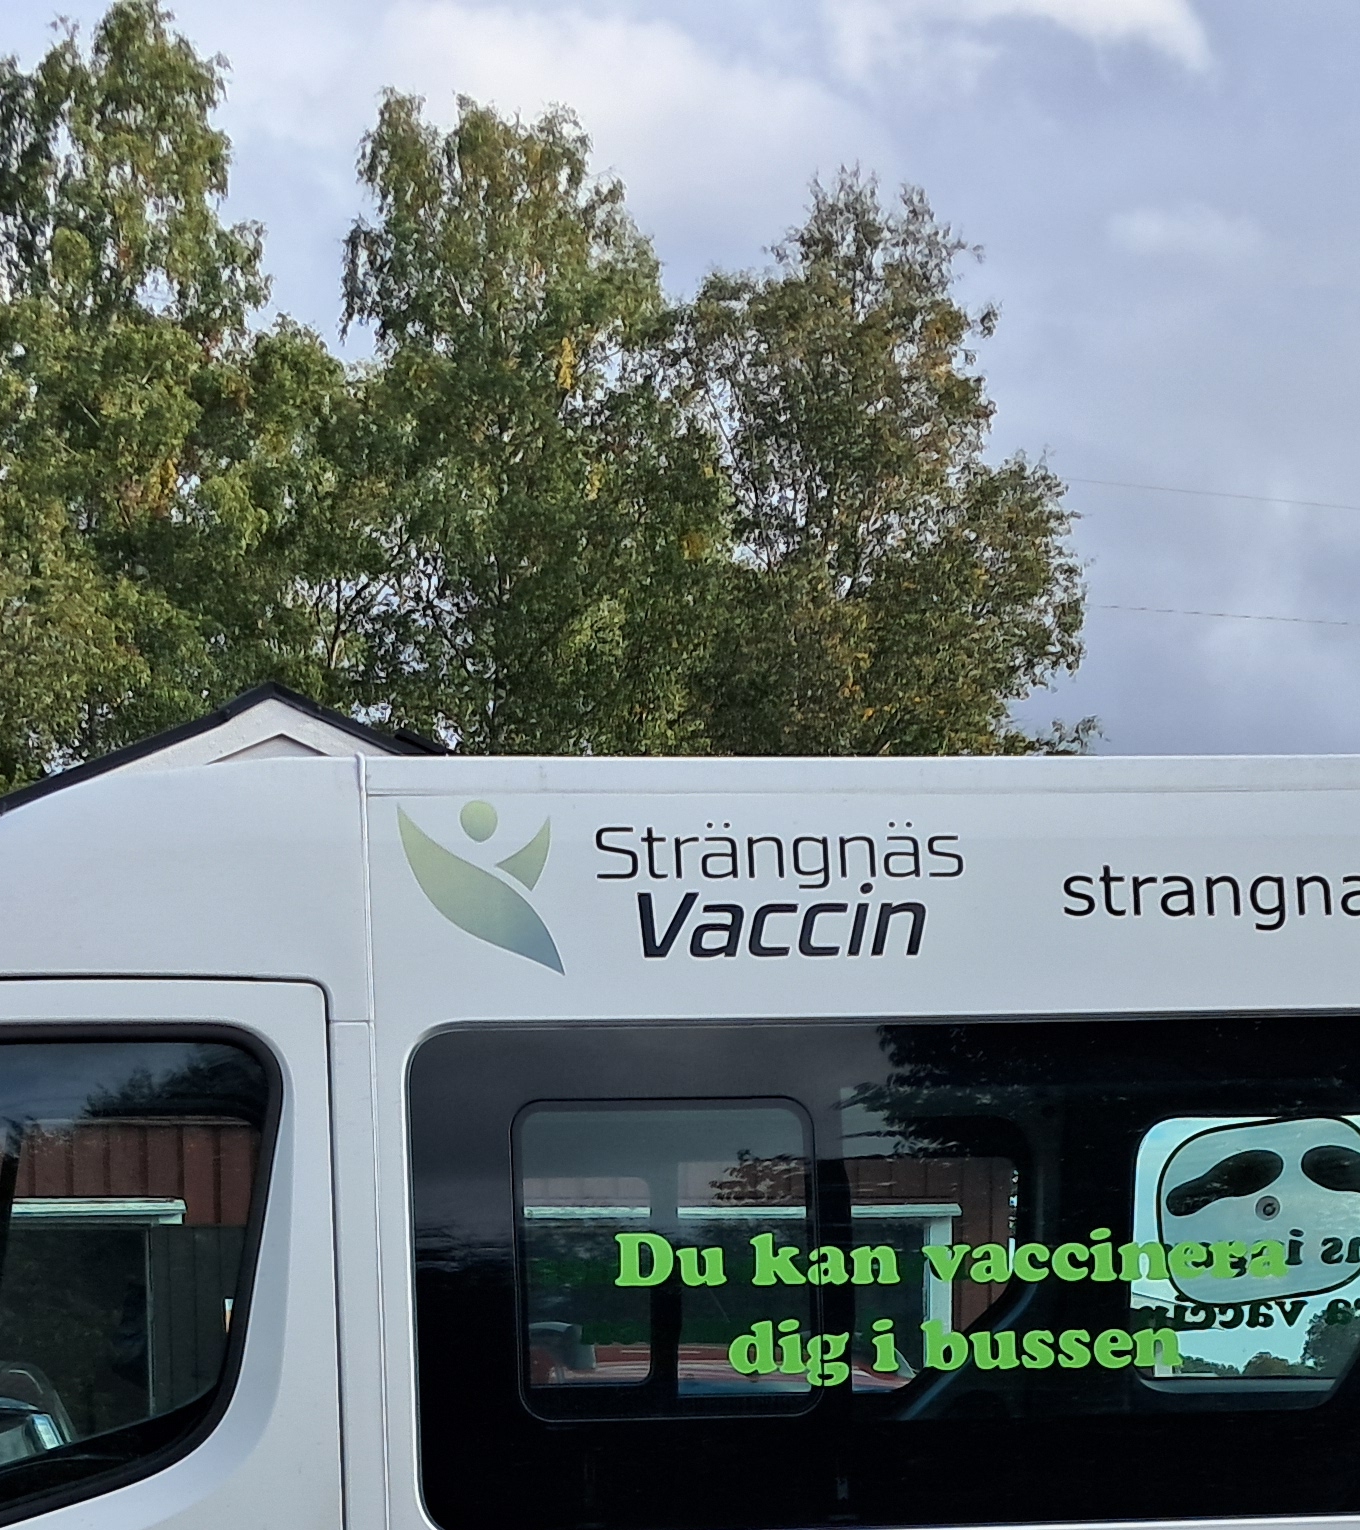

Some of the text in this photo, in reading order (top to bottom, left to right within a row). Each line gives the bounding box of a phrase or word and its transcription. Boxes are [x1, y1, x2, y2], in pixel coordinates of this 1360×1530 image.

[596, 821, 963, 890] Strängnäs
[636, 882, 927, 958] Vaccin
[616, 1233, 727, 1287] Du
[751, 1232, 901, 1286] kan
[924, 1228, 1288, 1283] vaccinera
[729, 1318, 1182, 1387] dig i bussen
